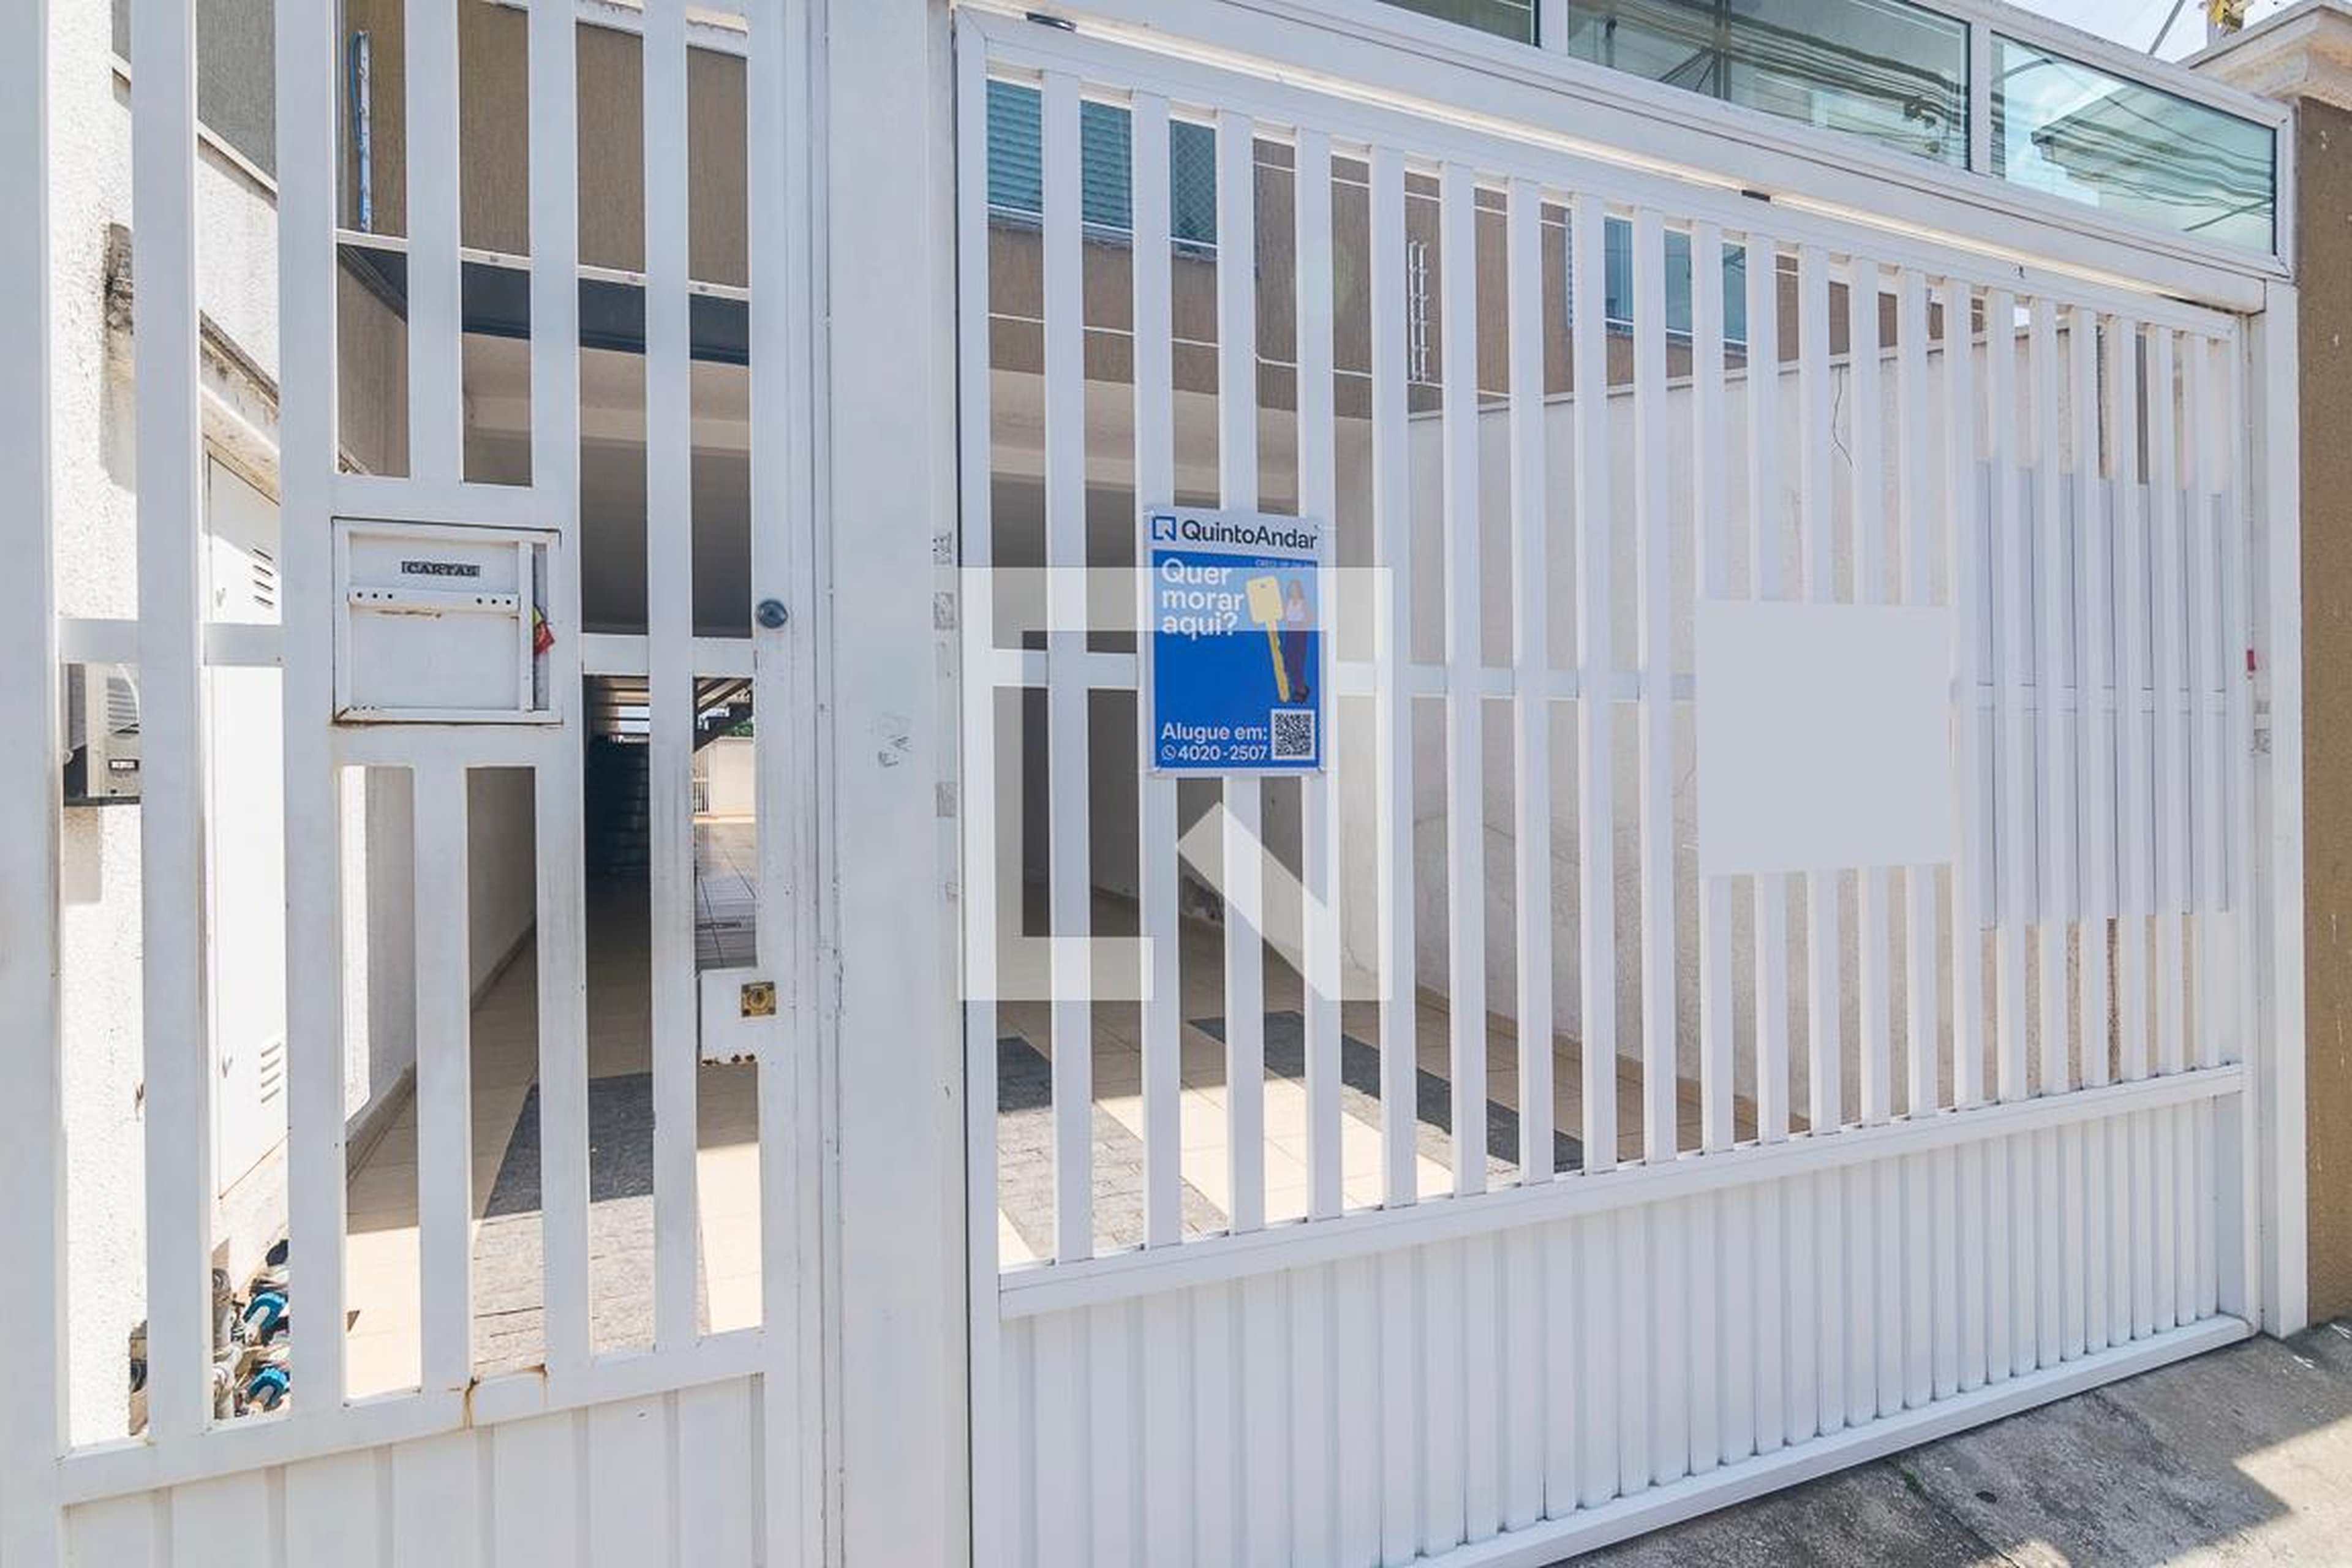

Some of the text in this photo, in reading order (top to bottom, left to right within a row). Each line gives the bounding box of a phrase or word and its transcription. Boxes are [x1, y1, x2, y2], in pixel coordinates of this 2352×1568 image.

[1182, 519, 1317, 549] QuintoAndar
[1162, 558, 1231, 585] Quer
[1162, 590, 1245, 611] morar
[1162, 612, 1238, 640] aqui?
[1161, 722, 1268, 744] Alugue em:
